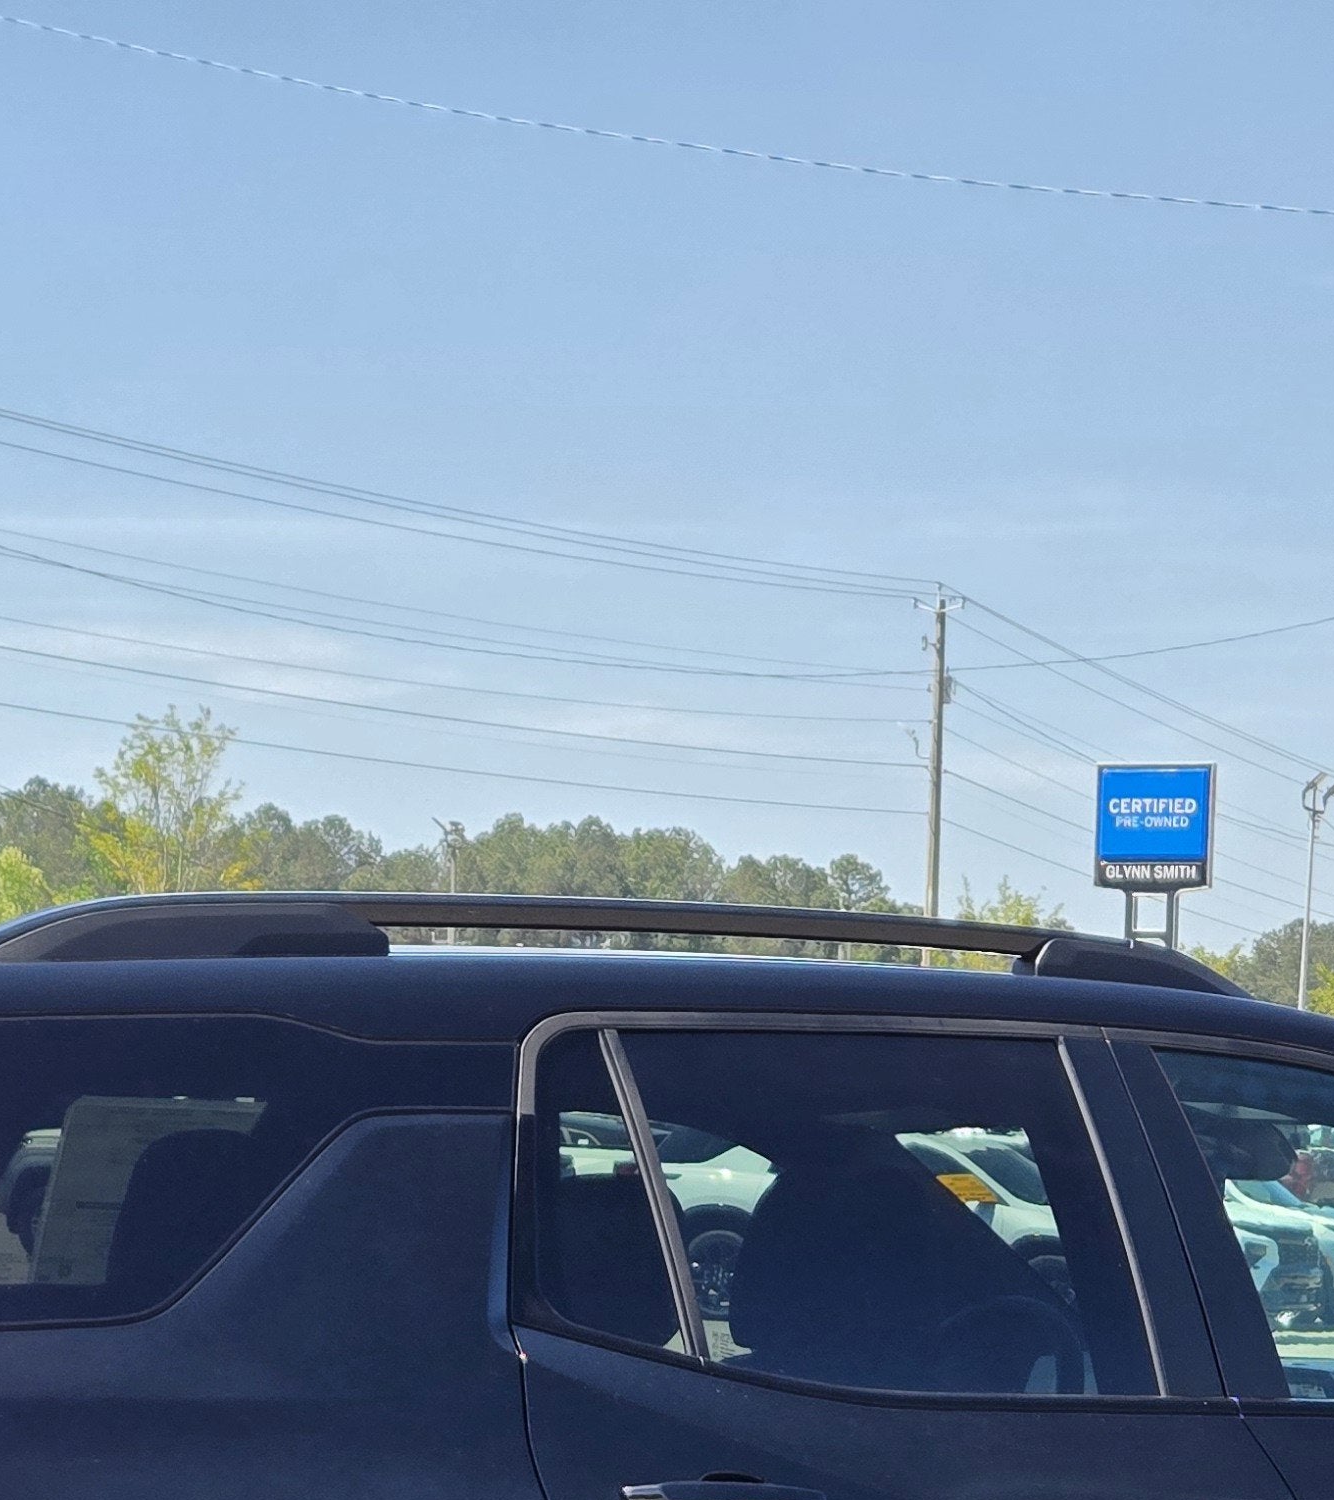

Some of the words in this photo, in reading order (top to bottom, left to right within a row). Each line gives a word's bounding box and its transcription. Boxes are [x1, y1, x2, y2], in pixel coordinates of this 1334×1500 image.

[1108, 797, 1197, 814] CERTIFIED
[1115, 815, 1189, 828] PRE-OWNED
[1105, 865, 1150, 879] GLYNN
[1153, 865, 1197, 879] SMITH
